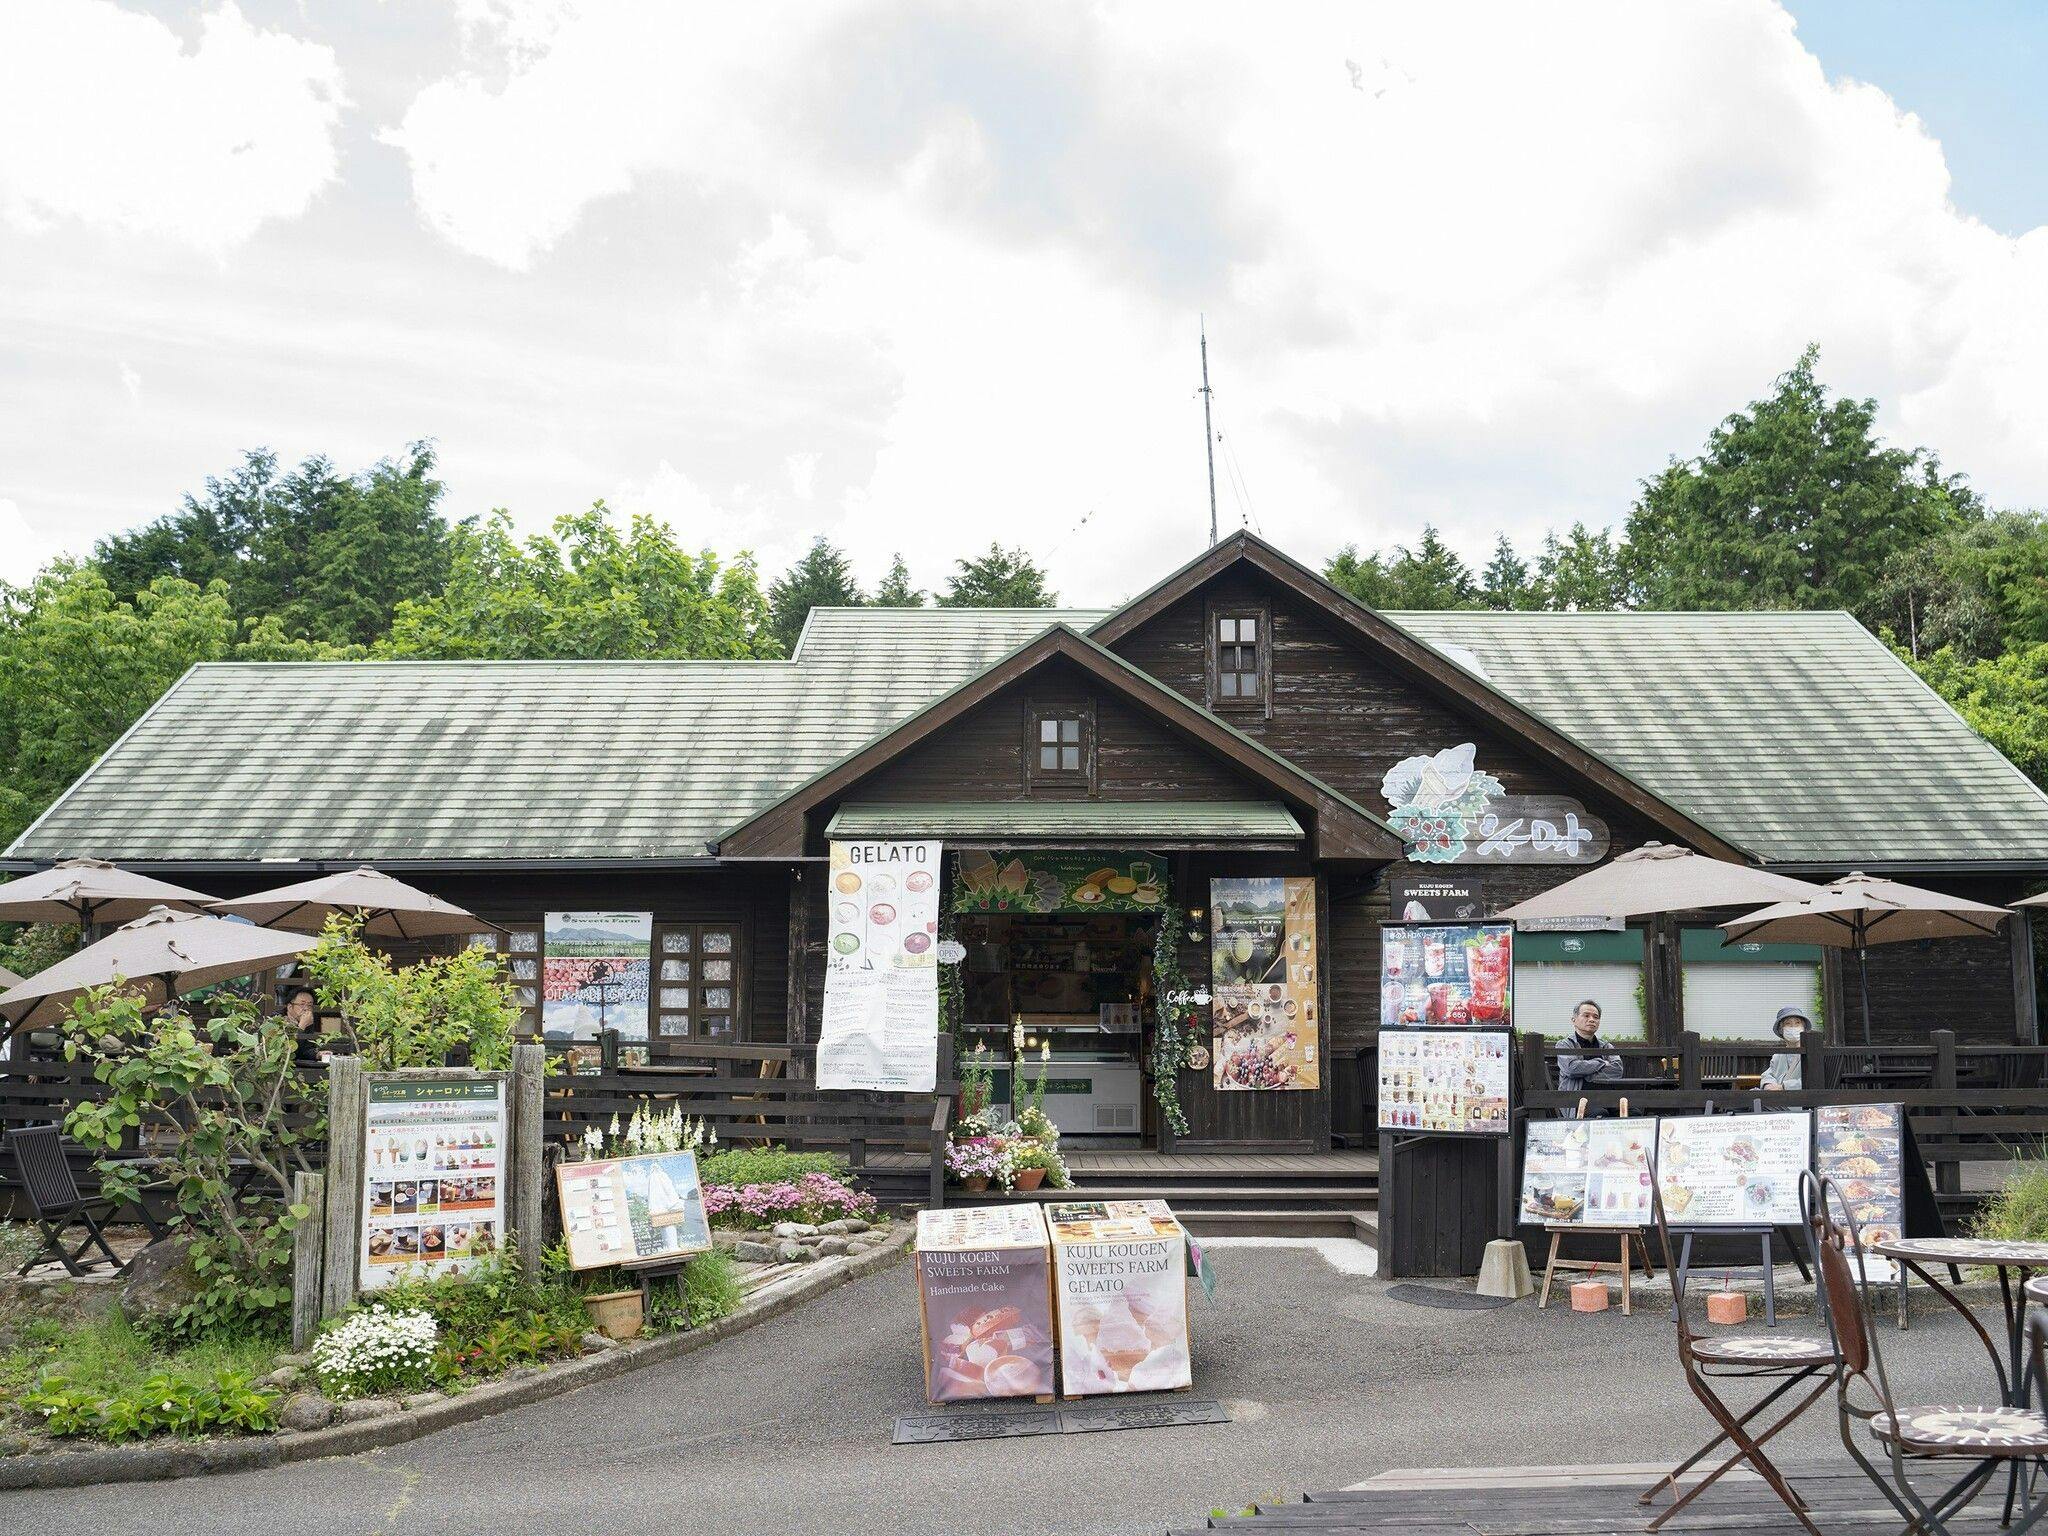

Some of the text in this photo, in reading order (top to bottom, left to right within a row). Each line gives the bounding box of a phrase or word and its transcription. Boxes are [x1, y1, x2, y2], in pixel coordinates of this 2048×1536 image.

[849, 844, 927, 864] GELATO
[1403, 889, 1469, 897] SWEETS FARM
[939, 948, 960, 958] OPEN
[1167, 990, 1195, 1005] Coffee
[415, 1086, 471, 1096] シャーロット
[925, 1251, 1000, 1264] KUJU KOGEN
[1066, 1243, 1168, 1260] KUJU KOUGEN
[926, 1264, 1010, 1278] SWEETS FARM
[1067, 1259, 1169, 1277] SWEETS FARM
[930, 1282, 1005, 1297] Handmade Cake
[1068, 1279, 1125, 1294] GELATO
